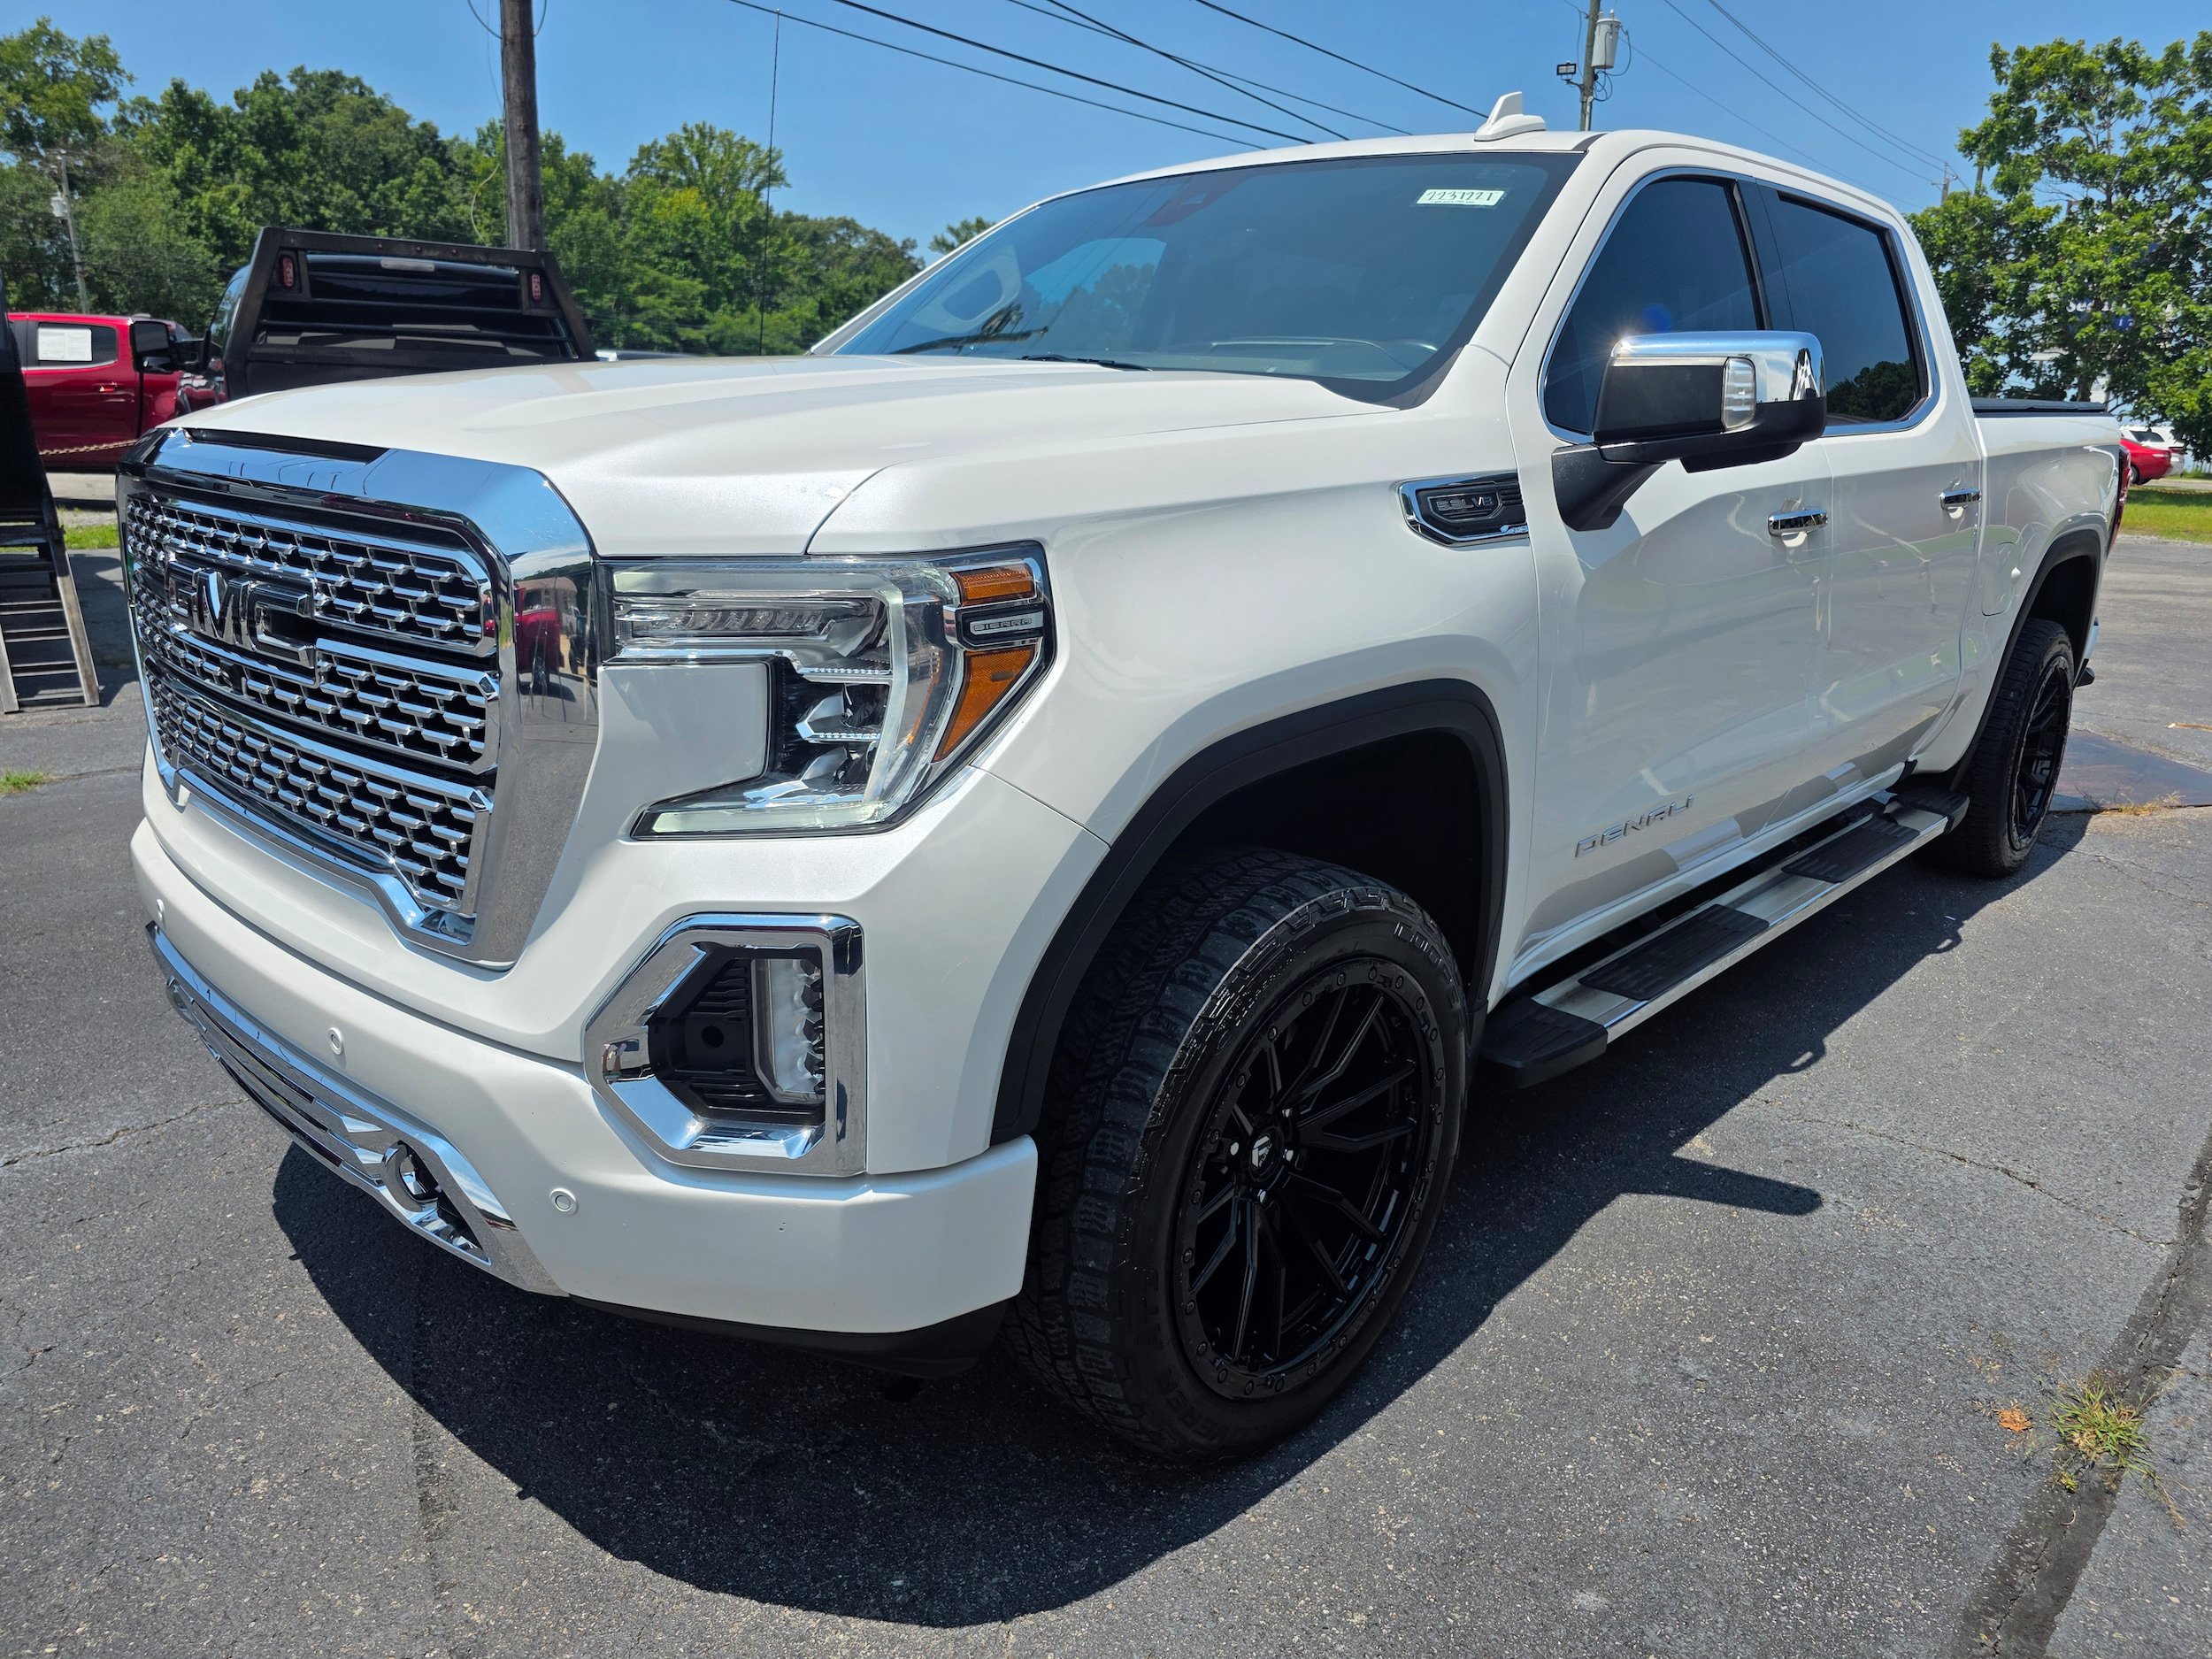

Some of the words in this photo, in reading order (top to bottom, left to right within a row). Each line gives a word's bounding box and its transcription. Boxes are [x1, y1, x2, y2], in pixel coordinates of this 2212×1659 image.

[166, 561, 315, 669] GMC
[973, 618, 1033, 632] SIERRA
[1574, 792, 1695, 858] DENALI
